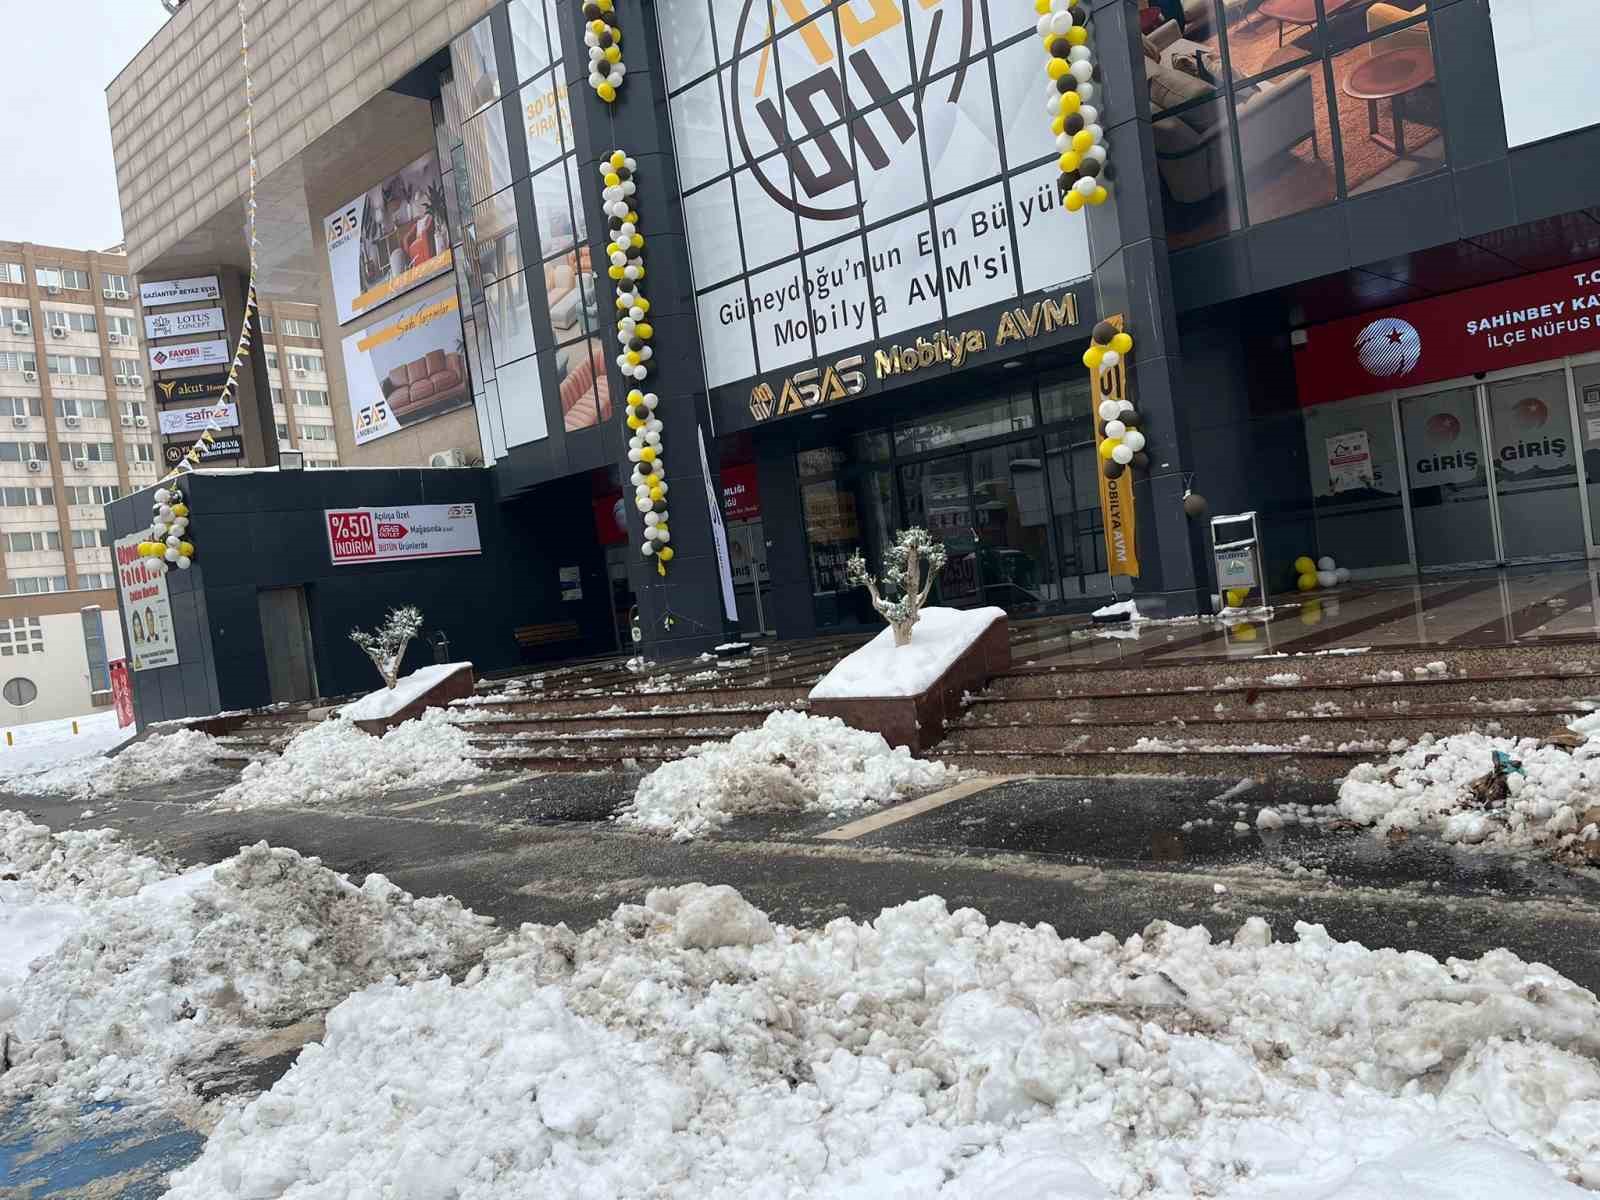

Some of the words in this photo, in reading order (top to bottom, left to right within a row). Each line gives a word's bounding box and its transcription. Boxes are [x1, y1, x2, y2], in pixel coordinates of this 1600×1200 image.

[917, 228, 957, 257] En
[179, 287, 199, 295] BEYAZ
[774, 295, 888, 347] Mobilya
[908, 245, 1009, 306] AVM'si
[177, 312, 210, 324] LOTUS
[177, 322, 210, 330] CONCEPT
[1465, 301, 1566, 336] ŞAHİNBEY
[1487, 329, 1528, 348] İLÇE
[1531, 316, 1592, 340] NÜFUS
[777, 354, 867, 416] ASAS
[874, 328, 987, 380] Mobilya
[995, 292, 1079, 346] AVM
[178, 383, 204, 394] akut
[1501, 436, 1568, 462] GİRİŞ
[1416, 450, 1478, 475] GİRİŞ
[331, 515, 371, 539] %50
[334, 538, 375, 556] İNDİRİM
[1112, 530, 1128, 562] AVM
